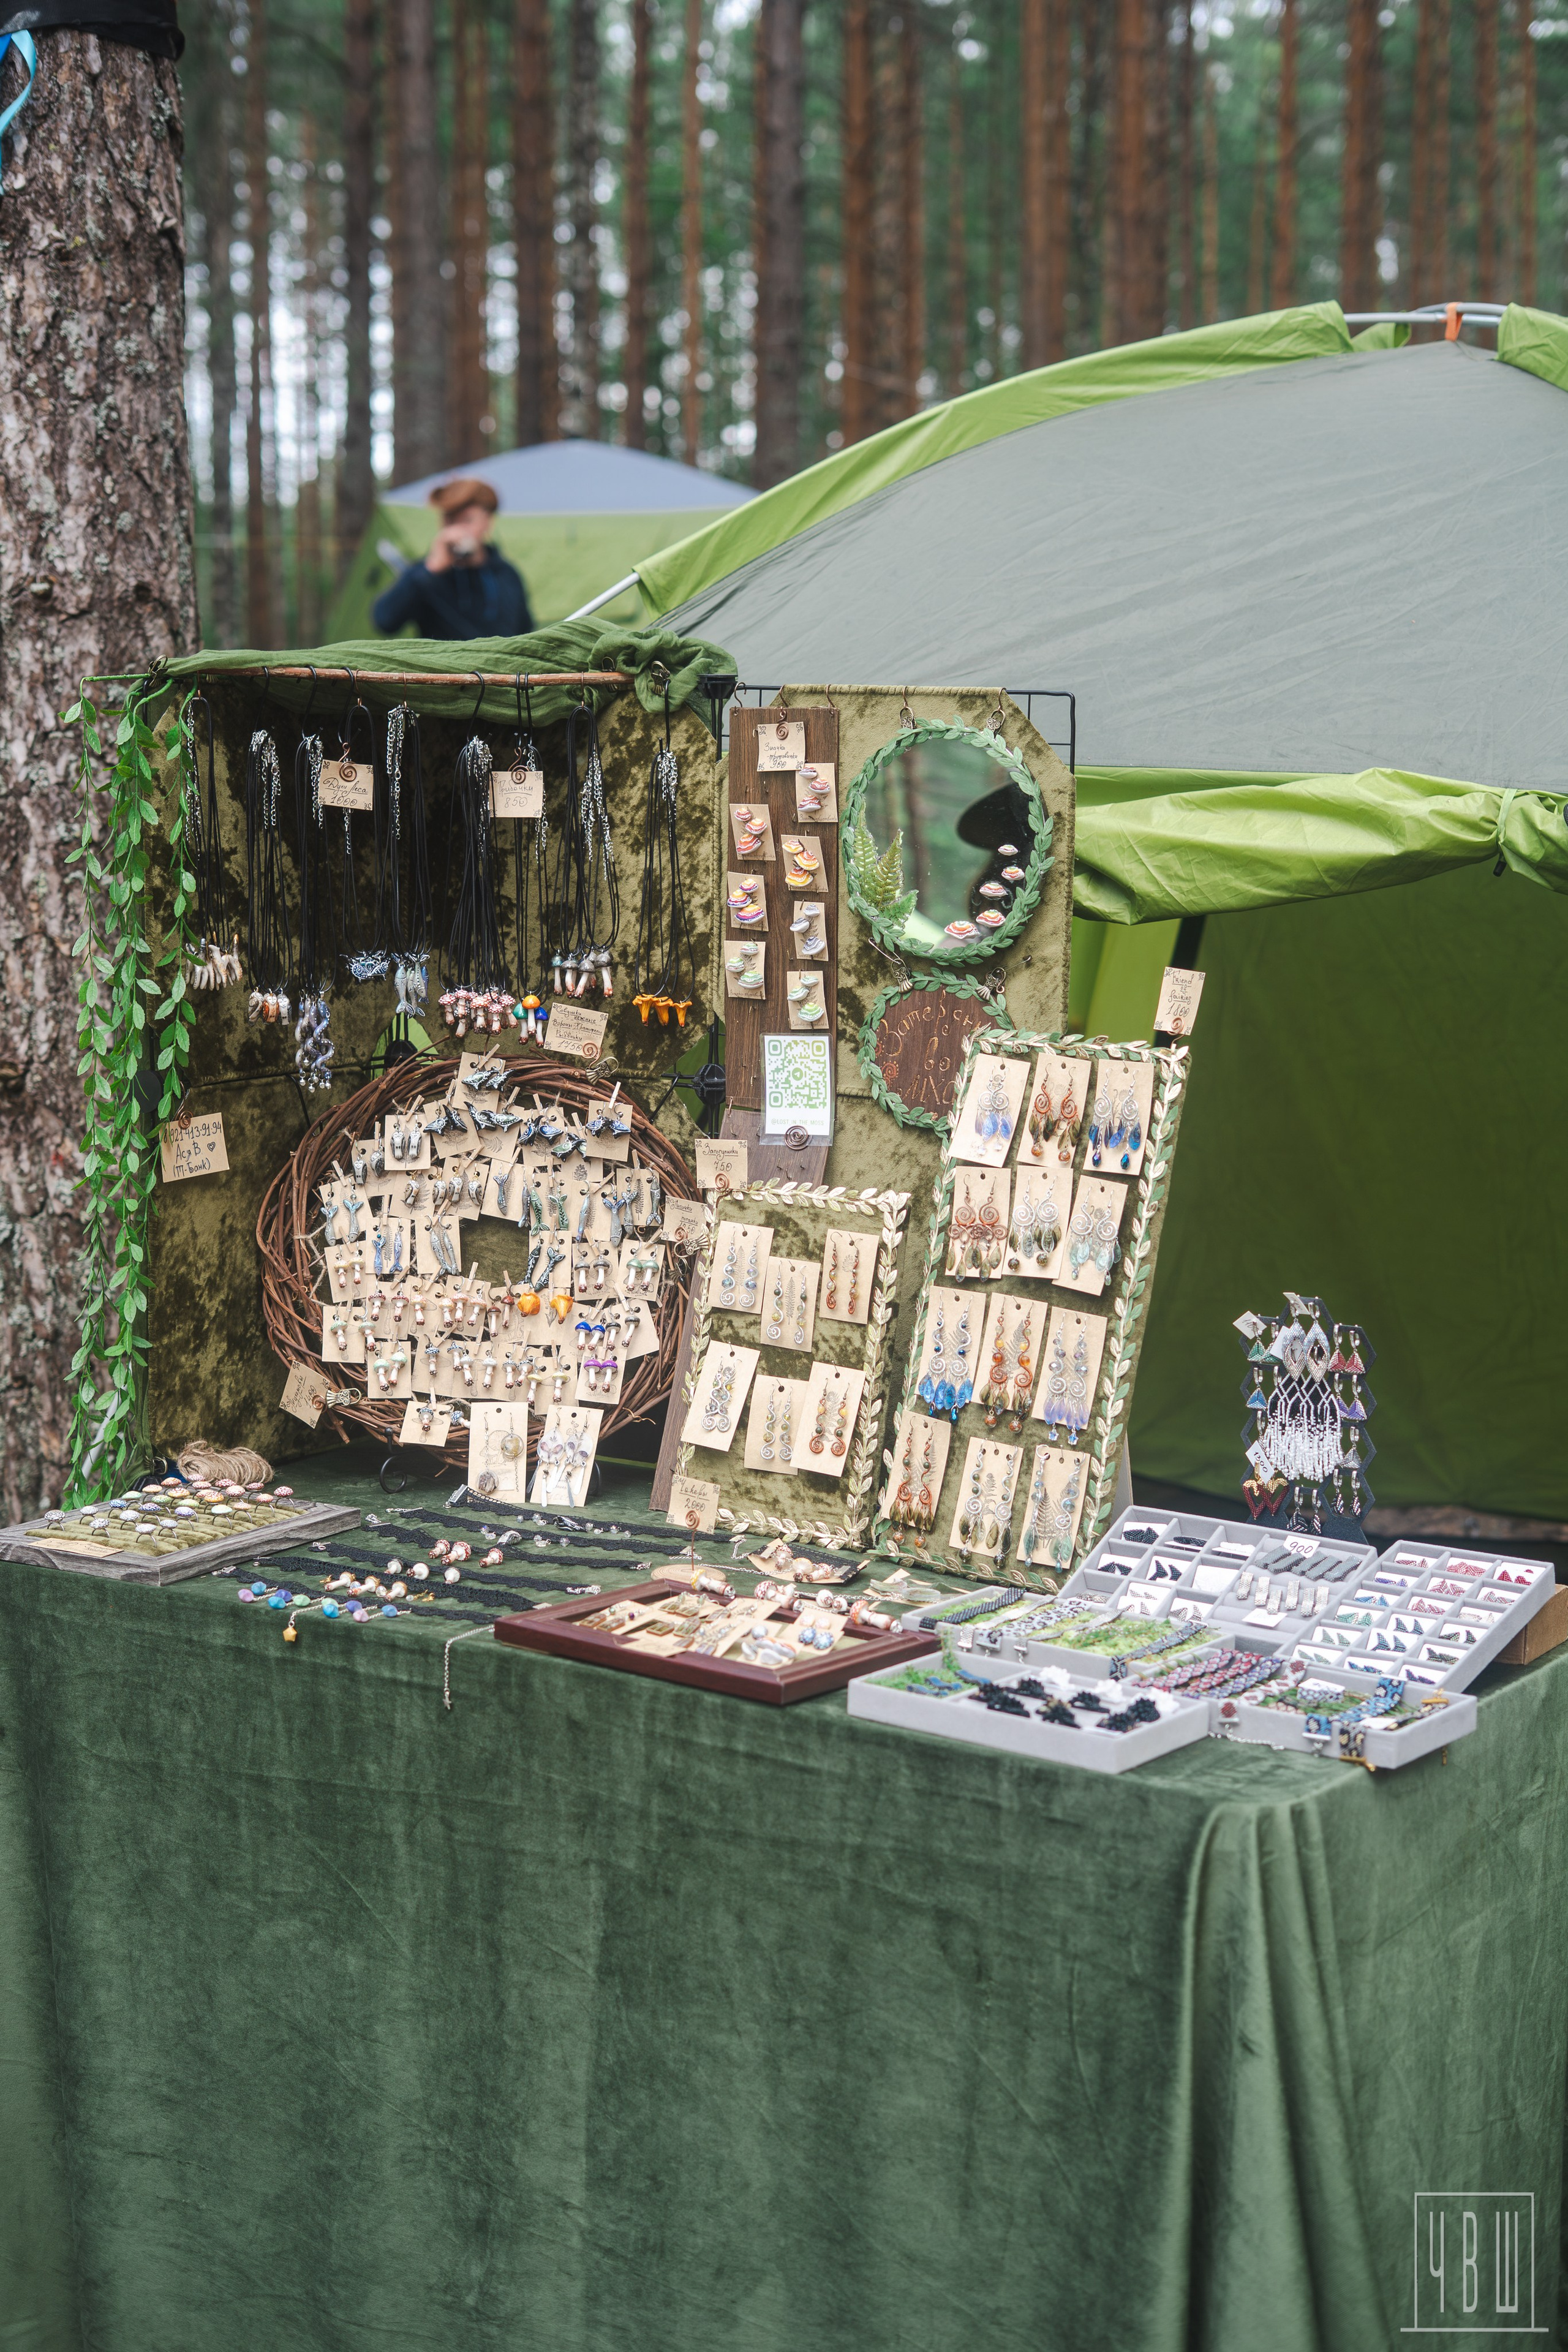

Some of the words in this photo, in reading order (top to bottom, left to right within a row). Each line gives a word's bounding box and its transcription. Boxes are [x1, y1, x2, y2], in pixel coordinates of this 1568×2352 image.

[770, 760, 787, 769] 900
[323, 777, 347, 795] Духи
[330, 794, 358, 807] 1000
[504, 796, 528, 808] 850
[1166, 1003, 1190, 1017] 1800
[557, 1040, 583, 1052] 1750
[176, 1143, 192, 1164] Ася
[714, 1161, 732, 1172] 750
[1254, 1452, 1268, 1473] 1300
[684, 1498, 706, 1512] 2000
[1289, 1541, 1313, 1554] 900
